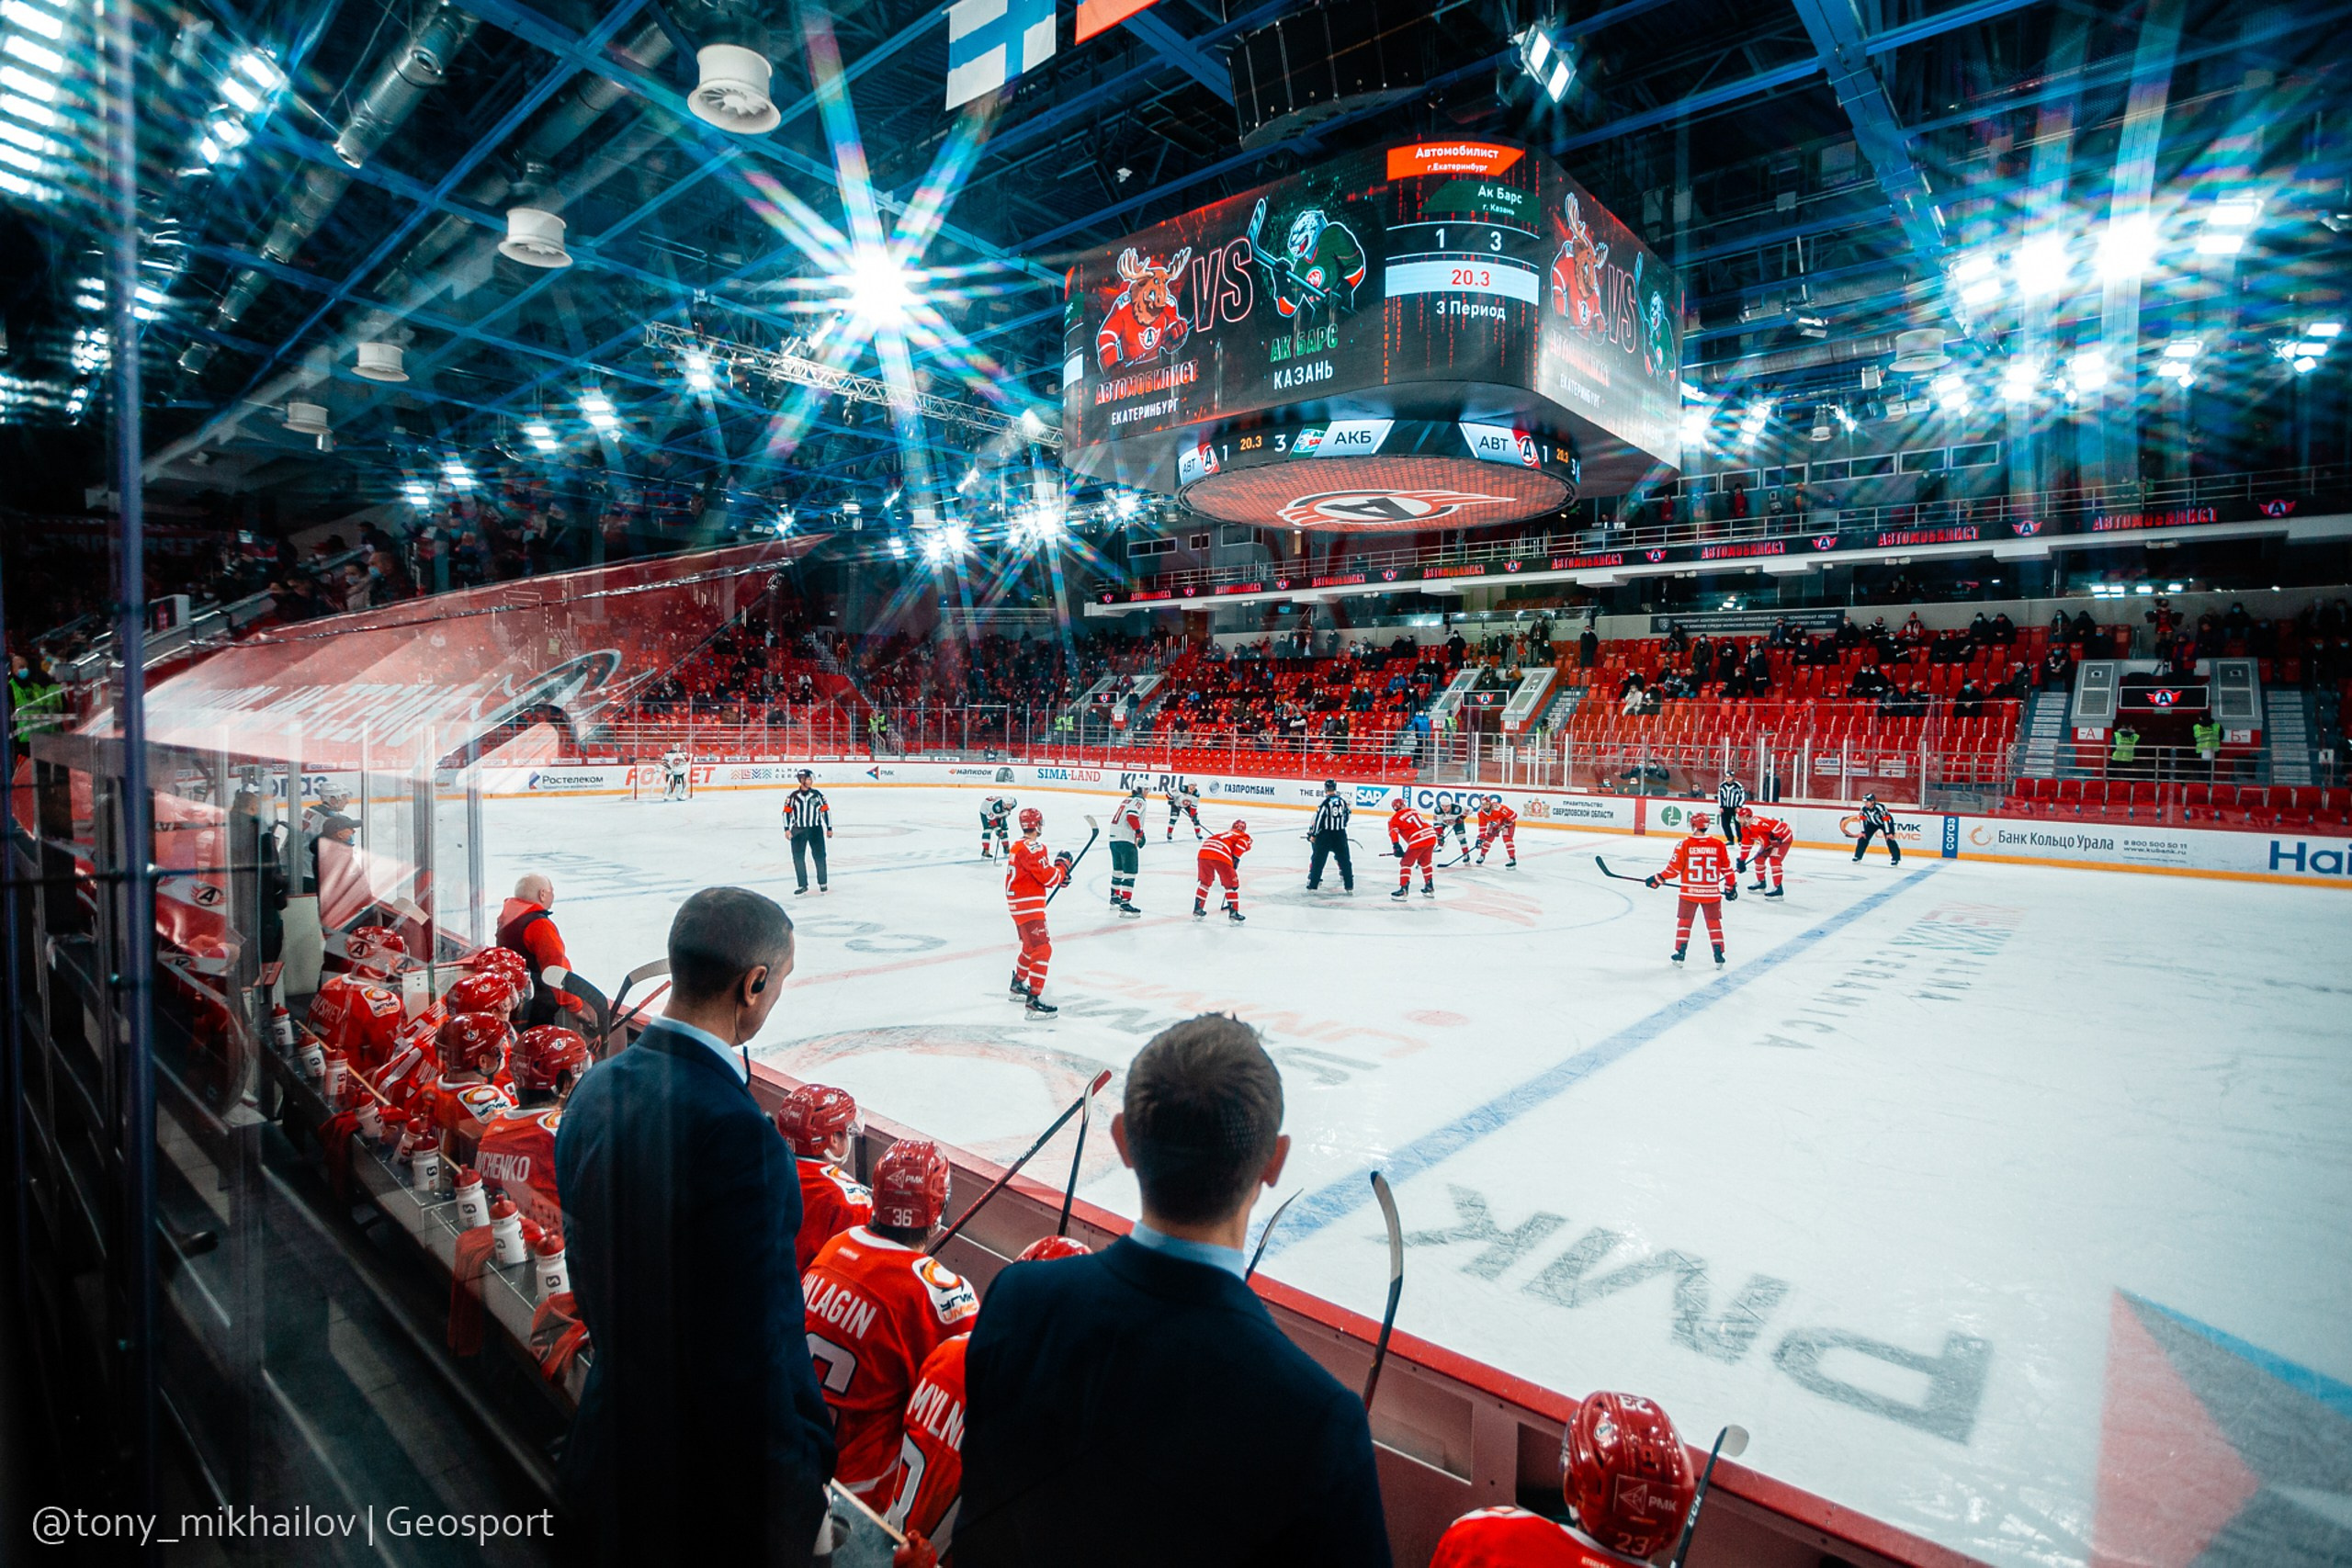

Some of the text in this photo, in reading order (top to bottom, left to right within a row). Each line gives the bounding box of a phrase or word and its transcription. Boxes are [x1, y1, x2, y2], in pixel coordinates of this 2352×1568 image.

[1415, 145, 1499, 159] Автомобилист
[1478, 185, 1522, 204] Ак Барс
[1490, 205, 1515, 216] Казань
[1435, 228, 1502, 251] 1 3
[1193, 236, 1253, 333] VS
[1452, 269, 1490, 287] 20.3
[1436, 300, 1506, 320] 3 Период
[1608, 264, 1636, 354] VS
[1270, 323, 1339, 363] АК БАРС
[1094, 359, 1199, 406] АВТОМОБИЛИСТ
[1273, 359, 1334, 390] КАЗАНЬ
[1111, 397, 1179, 426] ЕКАТЕРИНБУРГ
[1239, 434, 1262, 451] 20.3
[1274, 434, 1286, 452] 3
[1334, 430, 1372, 445] АКБ
[1479, 435, 1509, 452] АВТ
[1222, 445, 1228, 461] 1
[1543, 445, 1548, 463] 1
[1182, 457, 1196, 474] АВТ
[2092, 507, 2218, 531] АВТОМОБИЛИСТ
[1877, 525, 1980, 547] АВТОМОБИЛИСТ
[1702, 540, 1786, 558] АВТОМОБИЛИСТ
[542, 775, 604, 784] Ростелеком
[1037, 768, 1101, 782] SIMA-LAND
[1224, 783, 1275, 795] ГАЗПРОМБАНК
[1300, 788, 1314, 796] THE
[1356, 787, 1383, 805] SAP
[1590, 809, 1614, 818] ОБЛАСТИ
[1945, 818, 1956, 851] согаз
[1998, 829, 2114, 852] Банк Кольцо Урала
[1688, 856, 1717, 882] 55
[905, 1174, 924, 1184] РМК
[892, 1208, 913, 1227] 36
[907, 1377, 966, 1452] MYLN
[1648, 1495, 1677, 1512] РМК
[1687, 1494, 1702, 1528] CCM
[1614, 1530, 1650, 1556] 23
